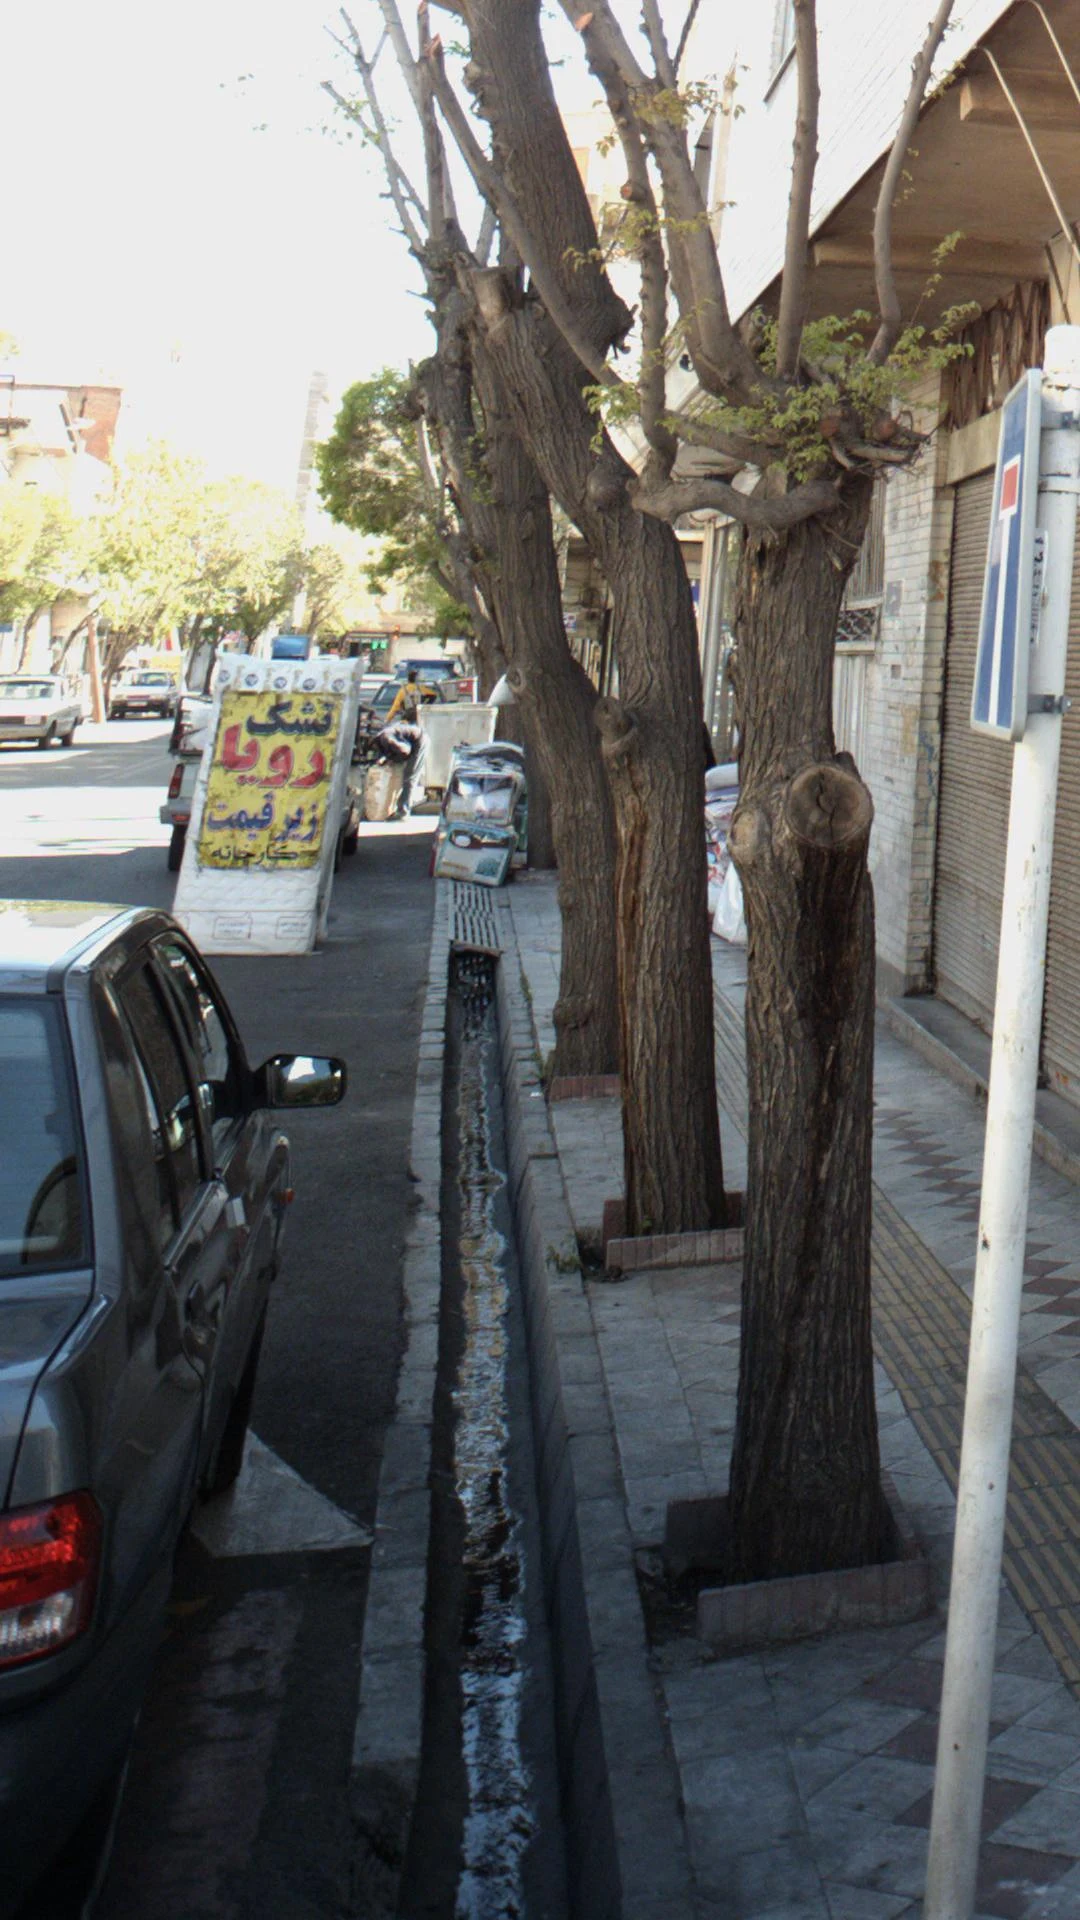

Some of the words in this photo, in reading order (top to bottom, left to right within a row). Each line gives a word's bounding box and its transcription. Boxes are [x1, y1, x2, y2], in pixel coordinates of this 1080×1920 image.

[246, 701, 333, 736] تشک
[221, 723, 327, 788] رویا
[206, 791, 275, 841] قیمت
[275, 802, 319, 843] زیر
[211, 843, 298, 865] کارخانه
